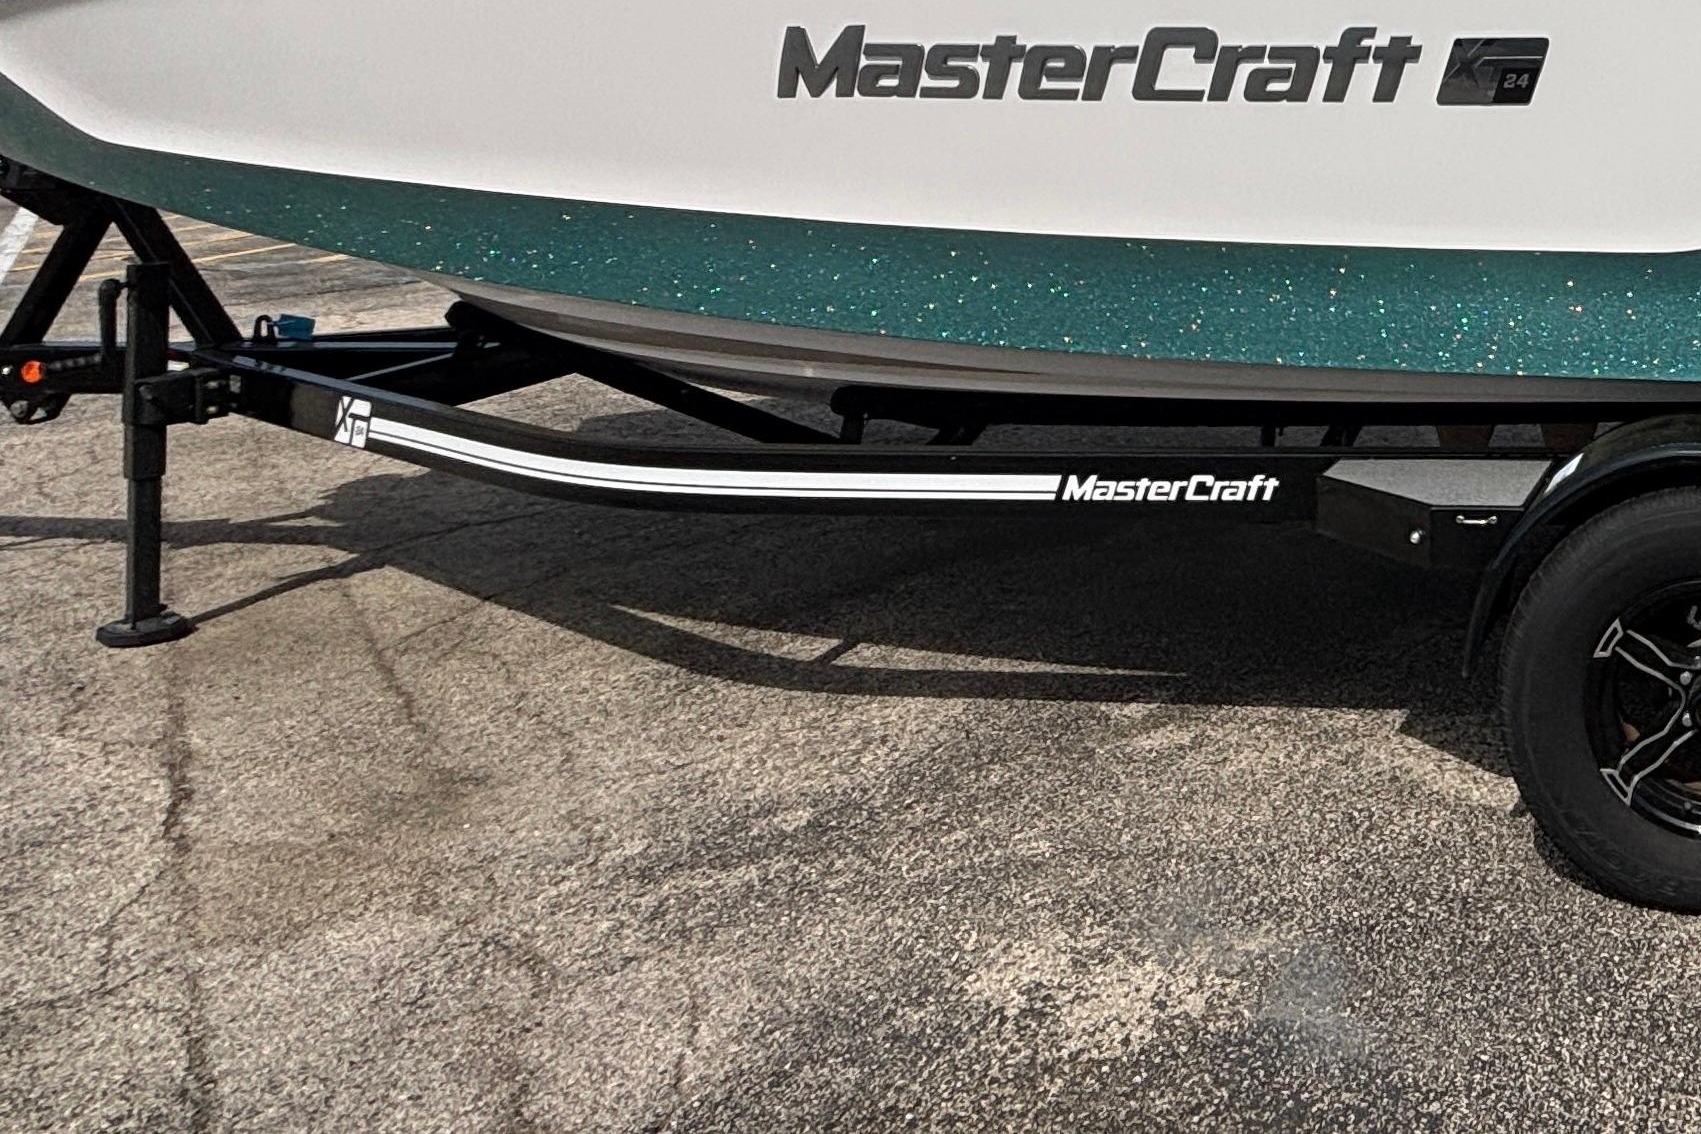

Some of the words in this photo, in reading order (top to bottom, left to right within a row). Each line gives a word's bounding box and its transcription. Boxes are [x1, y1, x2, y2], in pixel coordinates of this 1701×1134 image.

[776, 24, 1423, 103] MasterCraft
[1503, 73, 1530, 88] 24
[1062, 474, 1279, 501] MasterCraft
